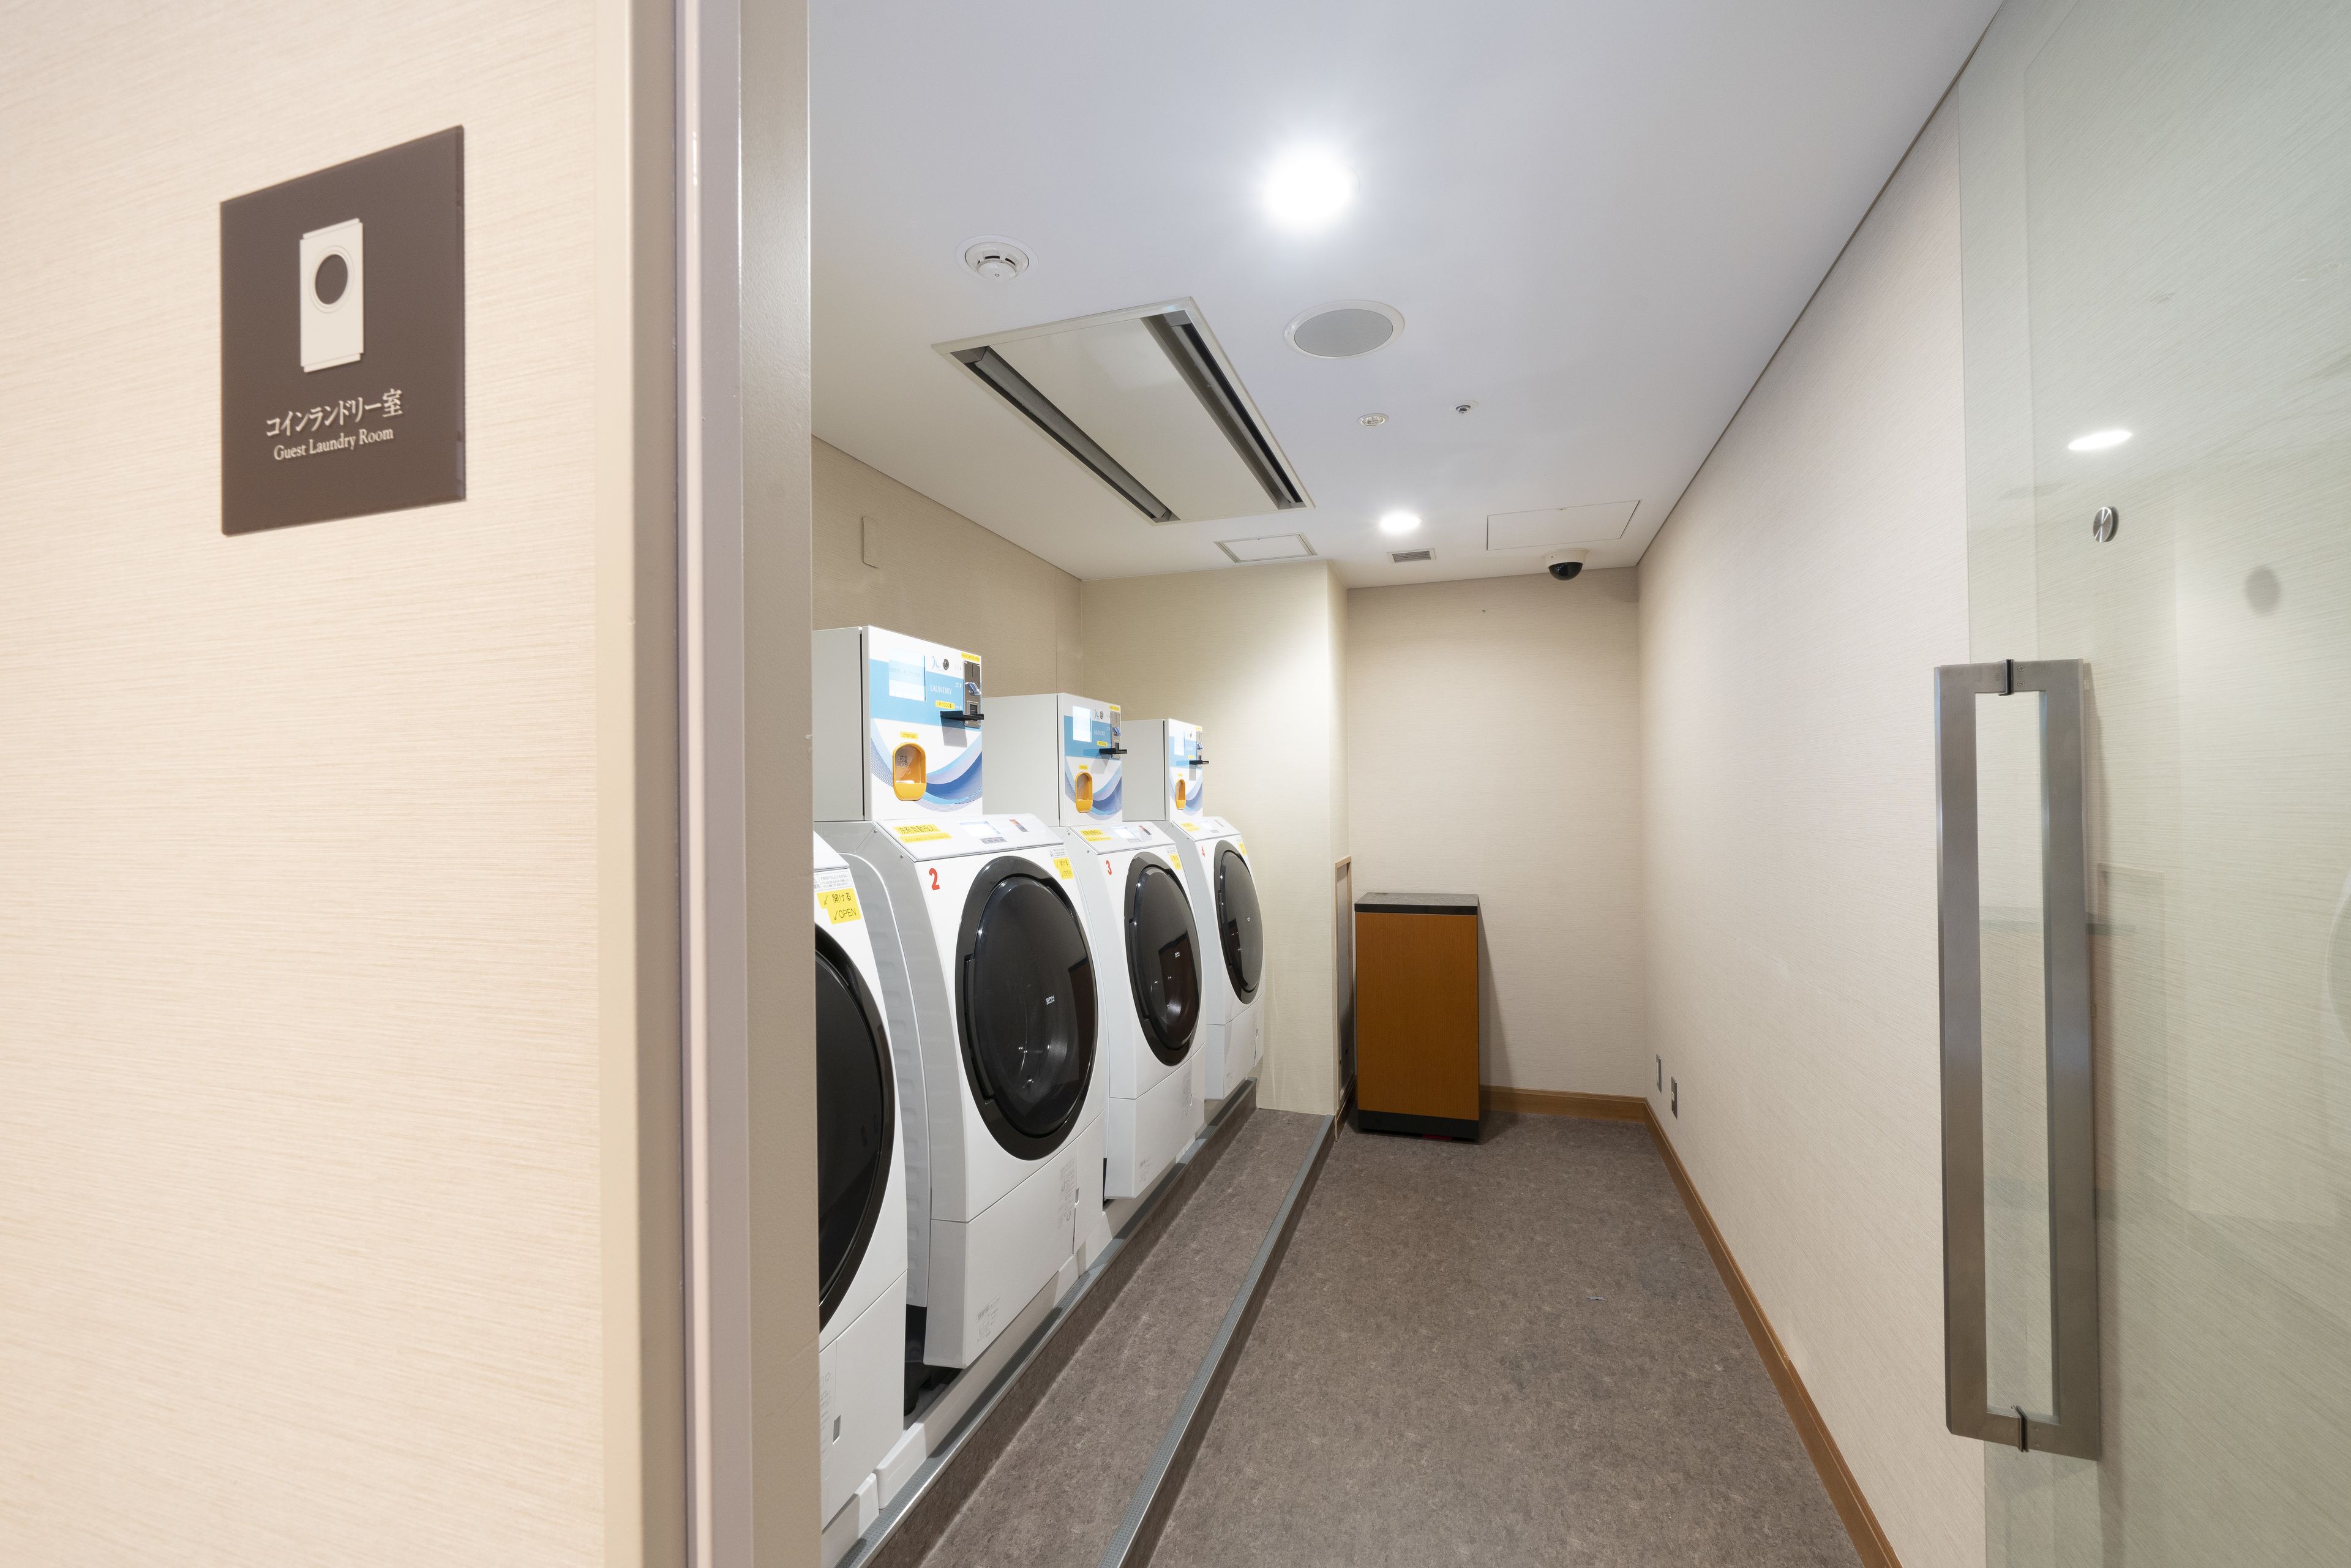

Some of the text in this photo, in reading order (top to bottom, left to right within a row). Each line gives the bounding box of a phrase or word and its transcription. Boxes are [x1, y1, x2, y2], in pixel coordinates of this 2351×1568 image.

[266, 388, 403, 436] コインランドリー室
[274, 429, 394, 460] Guest Laundry Room
[930, 685, 953, 695] LAUNDRY
[1201, 846, 1205, 857] 4
[1106, 860, 1112, 875] 3
[929, 868, 940, 890] 2
[832, 892, 852, 904] 開ける
[838, 908, 857, 918] OPEN
